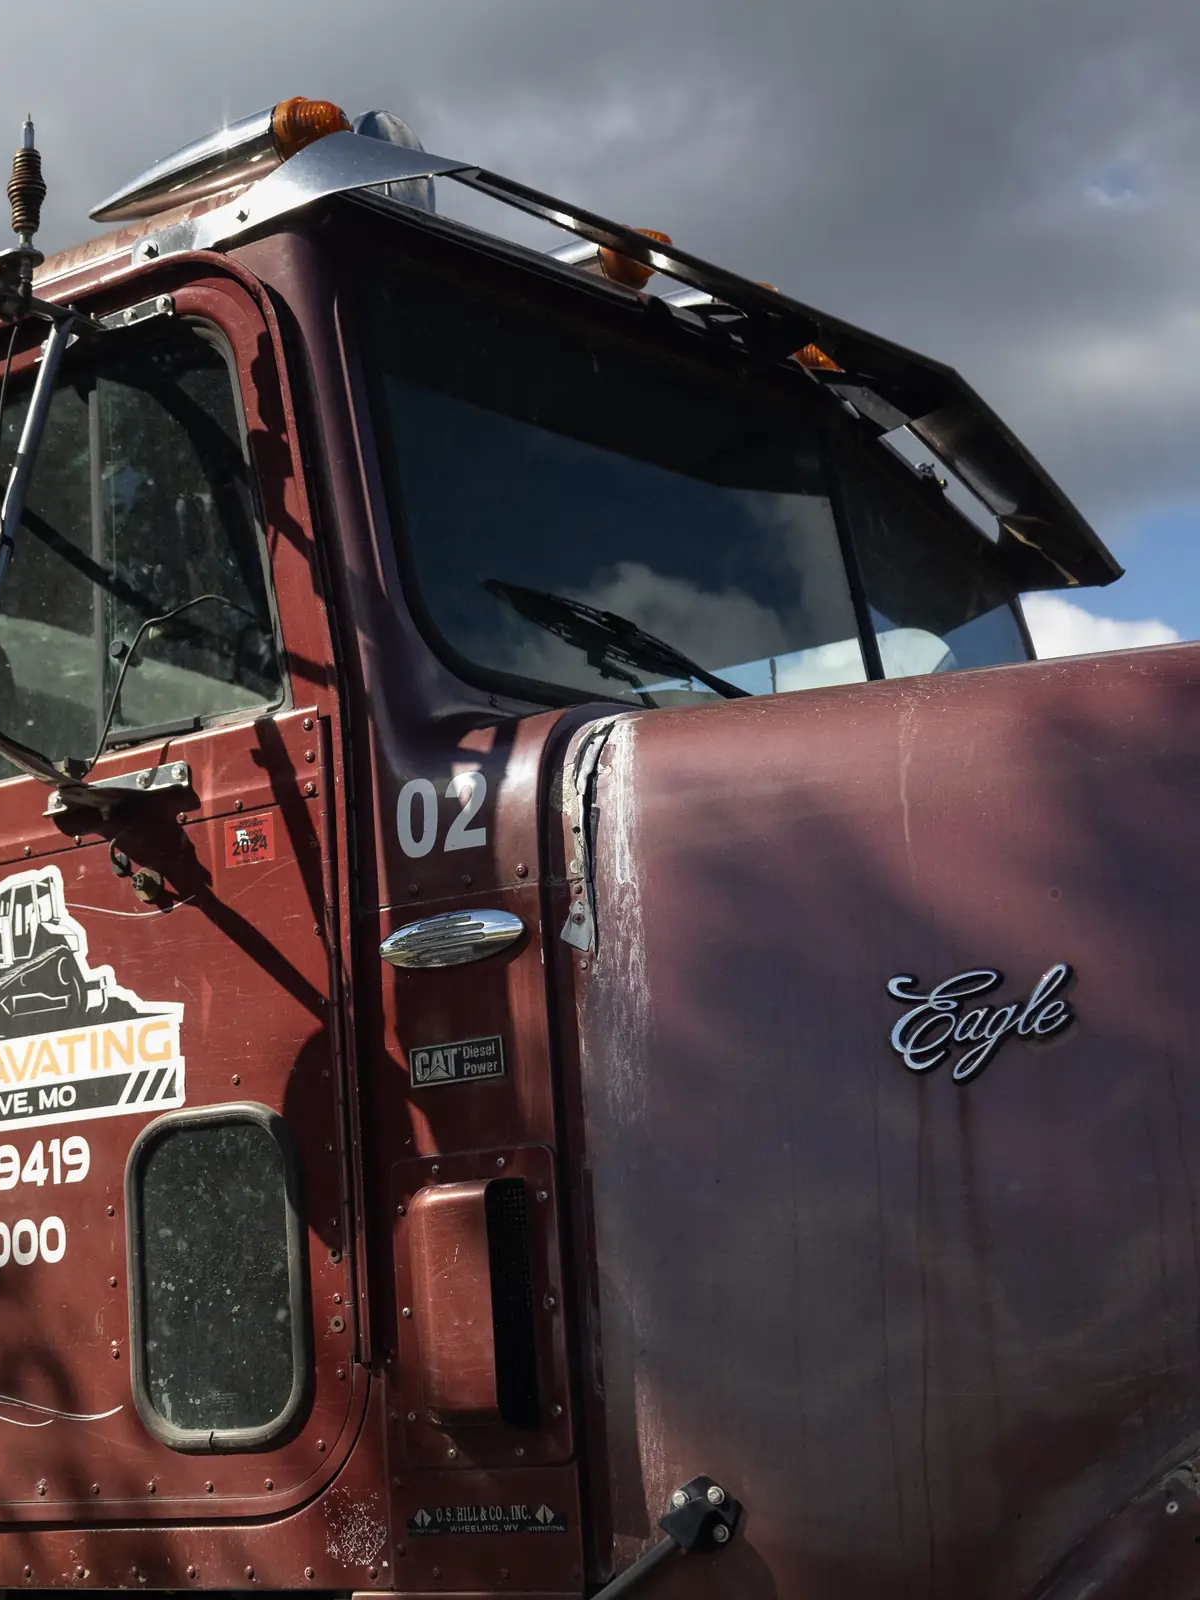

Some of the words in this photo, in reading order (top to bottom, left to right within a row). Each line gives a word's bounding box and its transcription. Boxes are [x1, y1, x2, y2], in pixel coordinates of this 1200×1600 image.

[396, 771, 488, 859] 02
[232, 833, 268, 856] 2024
[887, 963, 1069, 1080] Eagle
[462, 1041, 496, 1060] Diesel
[414, 1048, 458, 1082] CAT
[463, 1060, 498, 1076] Power
[38, 1085, 77, 1109] MO
[436, 1507, 455, 1523] O.S.
[456, 1506, 479, 1522] HILL
[480, 1506, 488, 1521] &
[489, 1505, 510, 1522] CO.,
[511, 1504, 532, 1521] INC.
[450, 1524, 502, 1533] WHEELING,
[504, 1524, 519, 1532] WV
